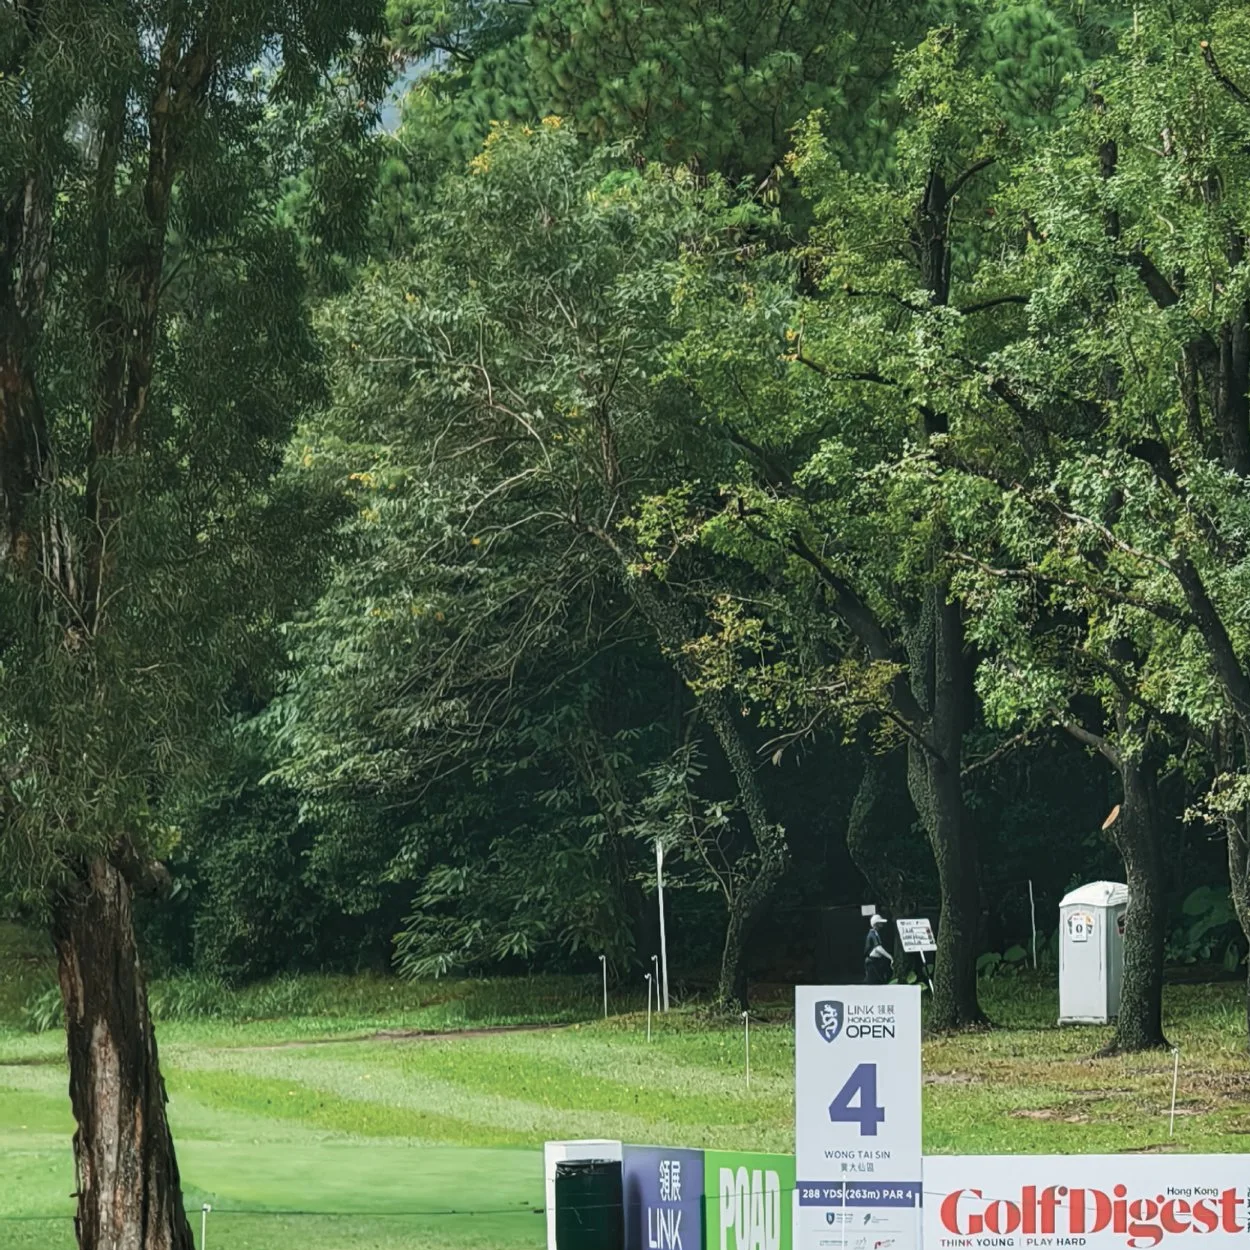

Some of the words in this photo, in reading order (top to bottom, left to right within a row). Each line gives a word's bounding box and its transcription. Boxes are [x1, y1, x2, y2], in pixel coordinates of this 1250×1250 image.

[847, 1005, 874, 1015] LINK
[846, 1025, 895, 1038] OPEN
[828, 1063, 885, 1136] 4
[824, 1150, 855, 1159] WONG
[857, 1151, 873, 1159] TAI
[875, 1151, 891, 1159] SIN
[659, 1160, 682, 1202] 領展
[803, 1189, 820, 1199] 288
[823, 1189, 843, 1199] YDS
[845, 1188, 880, 1200] (263m)
[882, 1189, 904, 1199] PAR
[905, 1190, 913, 1199] 4
[1167, 1187, 1192, 1198] Hong
[1194, 1187, 1219, 1198] Kong
[940, 1239, 973, 1247] THINK
[977, 1238, 1014, 1247] YOUNG
[1026, 1238, 1053, 1247] PLAY
[1056, 1237, 1086, 1246] HARD
